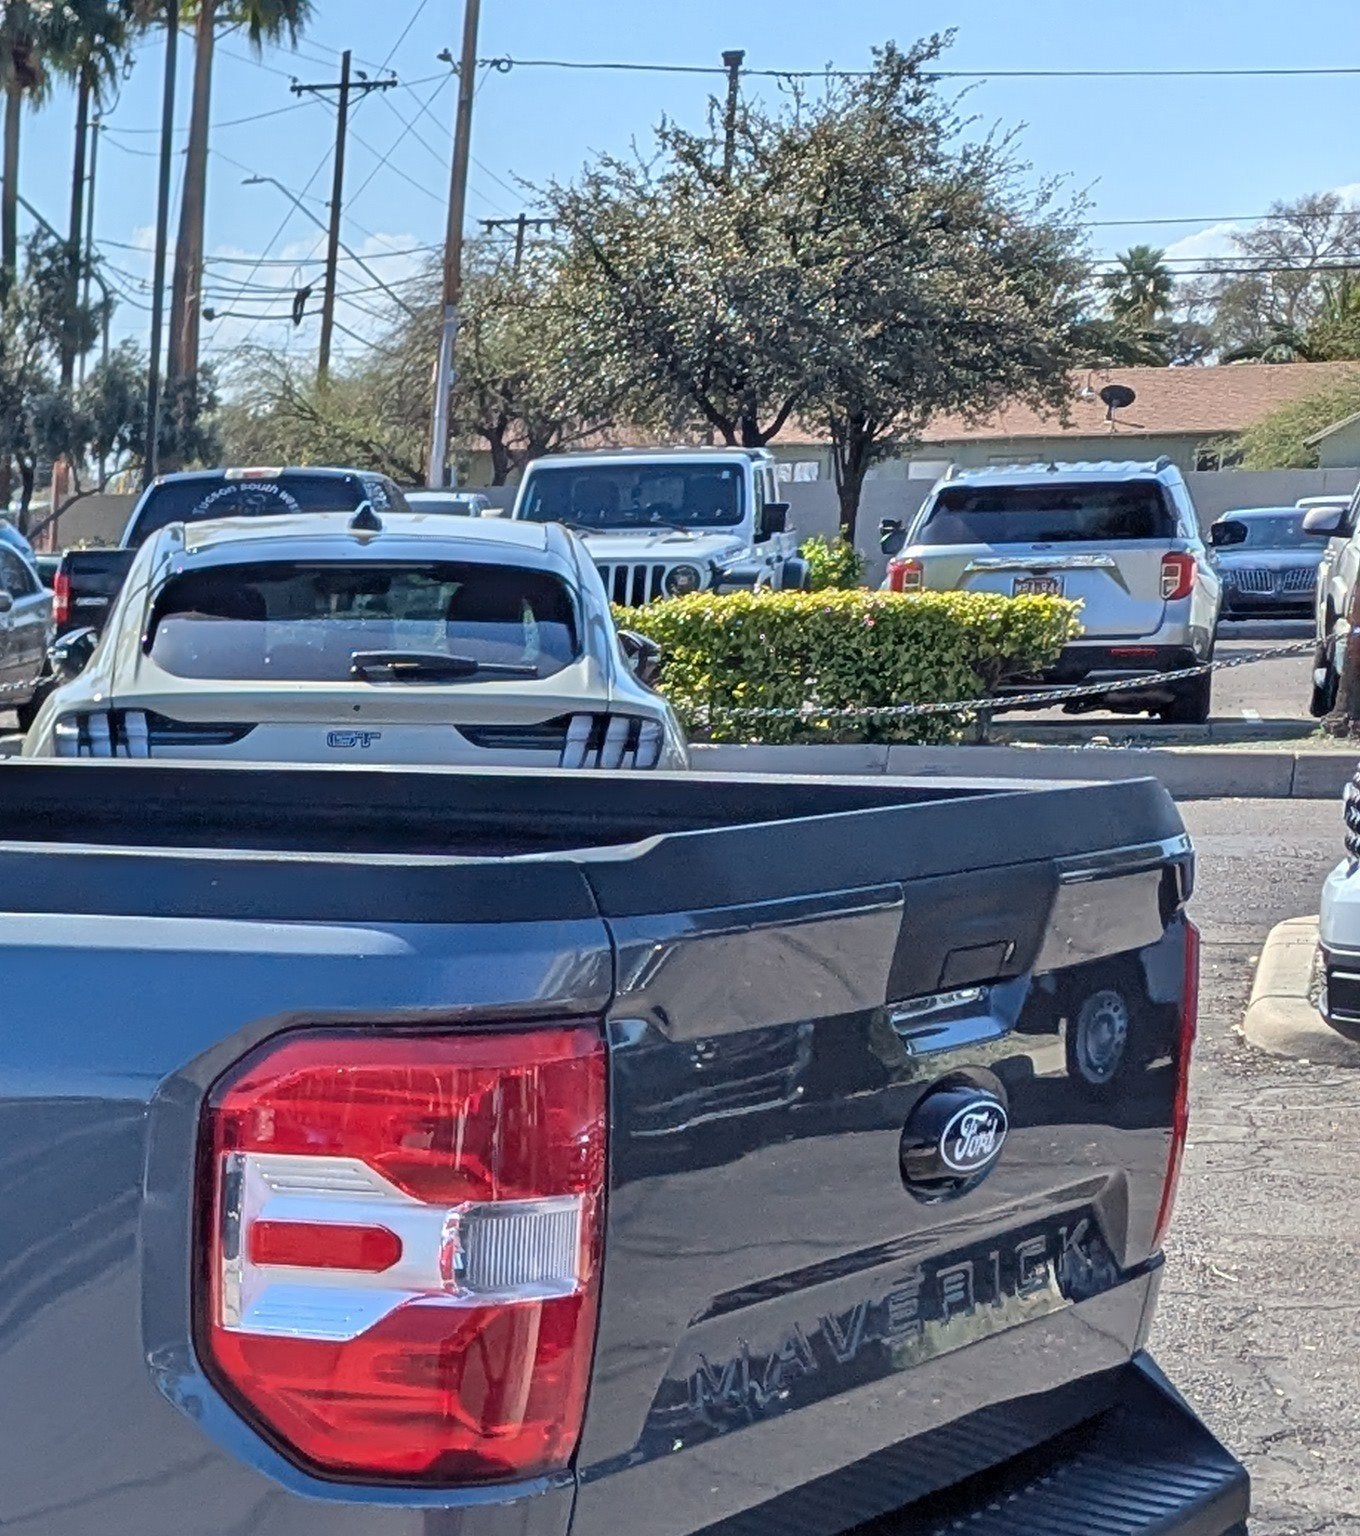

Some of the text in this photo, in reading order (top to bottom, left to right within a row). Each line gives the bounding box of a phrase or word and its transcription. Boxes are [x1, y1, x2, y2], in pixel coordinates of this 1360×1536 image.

[326, 729, 382, 748] GT
[952, 1109, 1000, 1162] Ford
[686, 1217, 1093, 1408] MAVERICK
